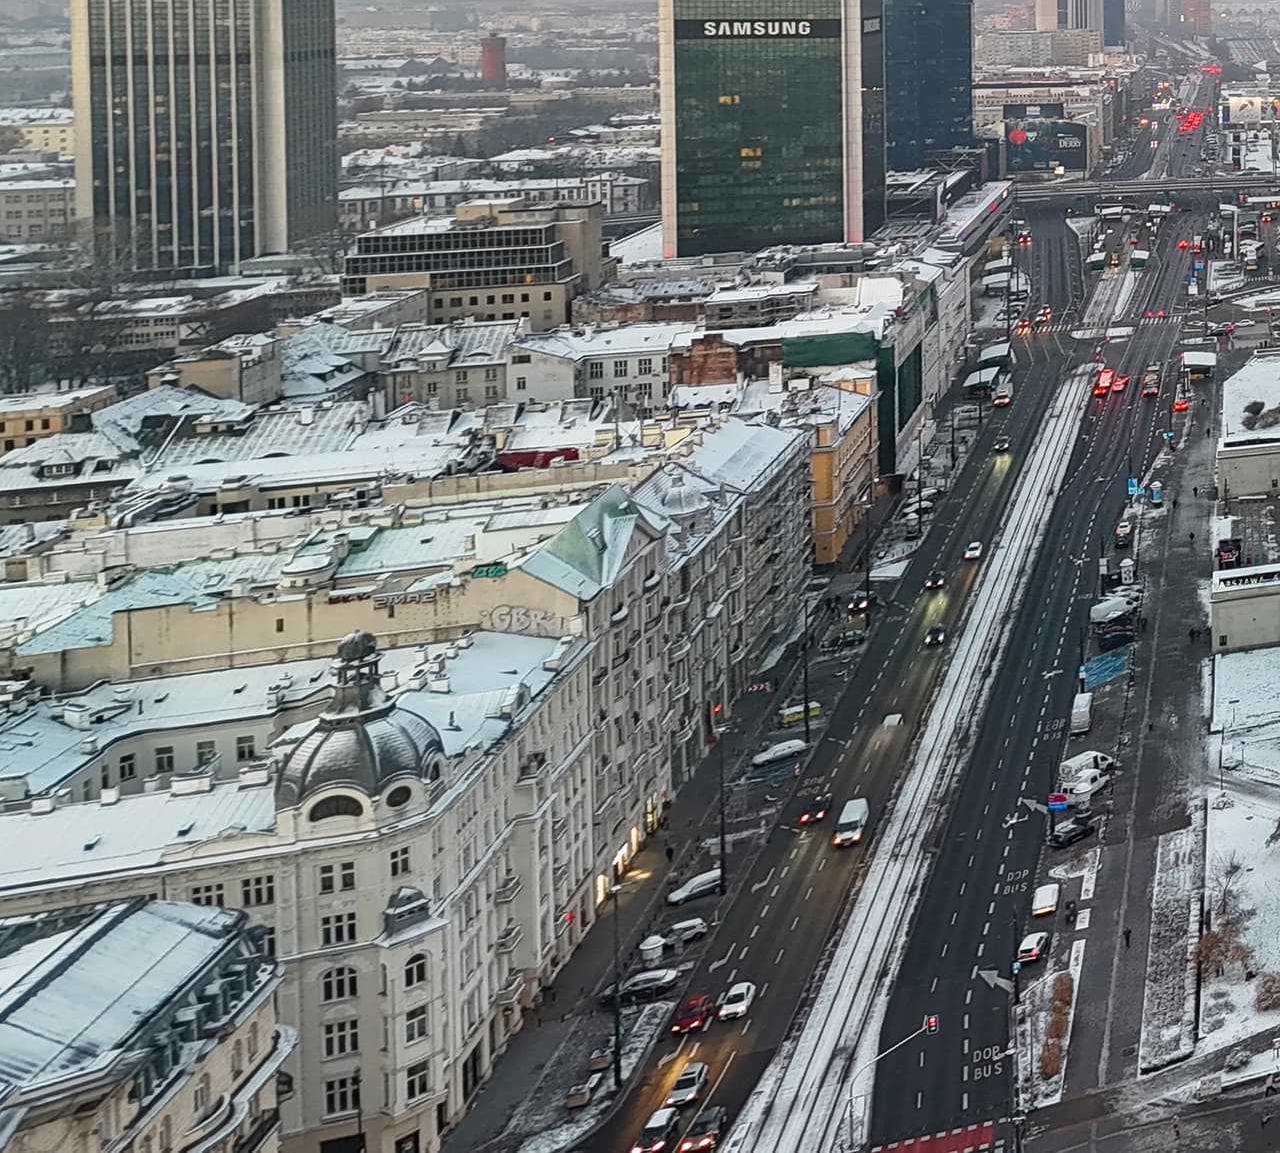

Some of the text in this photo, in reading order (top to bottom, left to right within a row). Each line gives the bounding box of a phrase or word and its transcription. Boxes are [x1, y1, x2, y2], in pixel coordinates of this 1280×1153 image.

[703, 21, 811, 36] SAMSUNG
[973, 1045, 1000, 1063] DOP
[974, 1062, 1003, 1081] BUS
